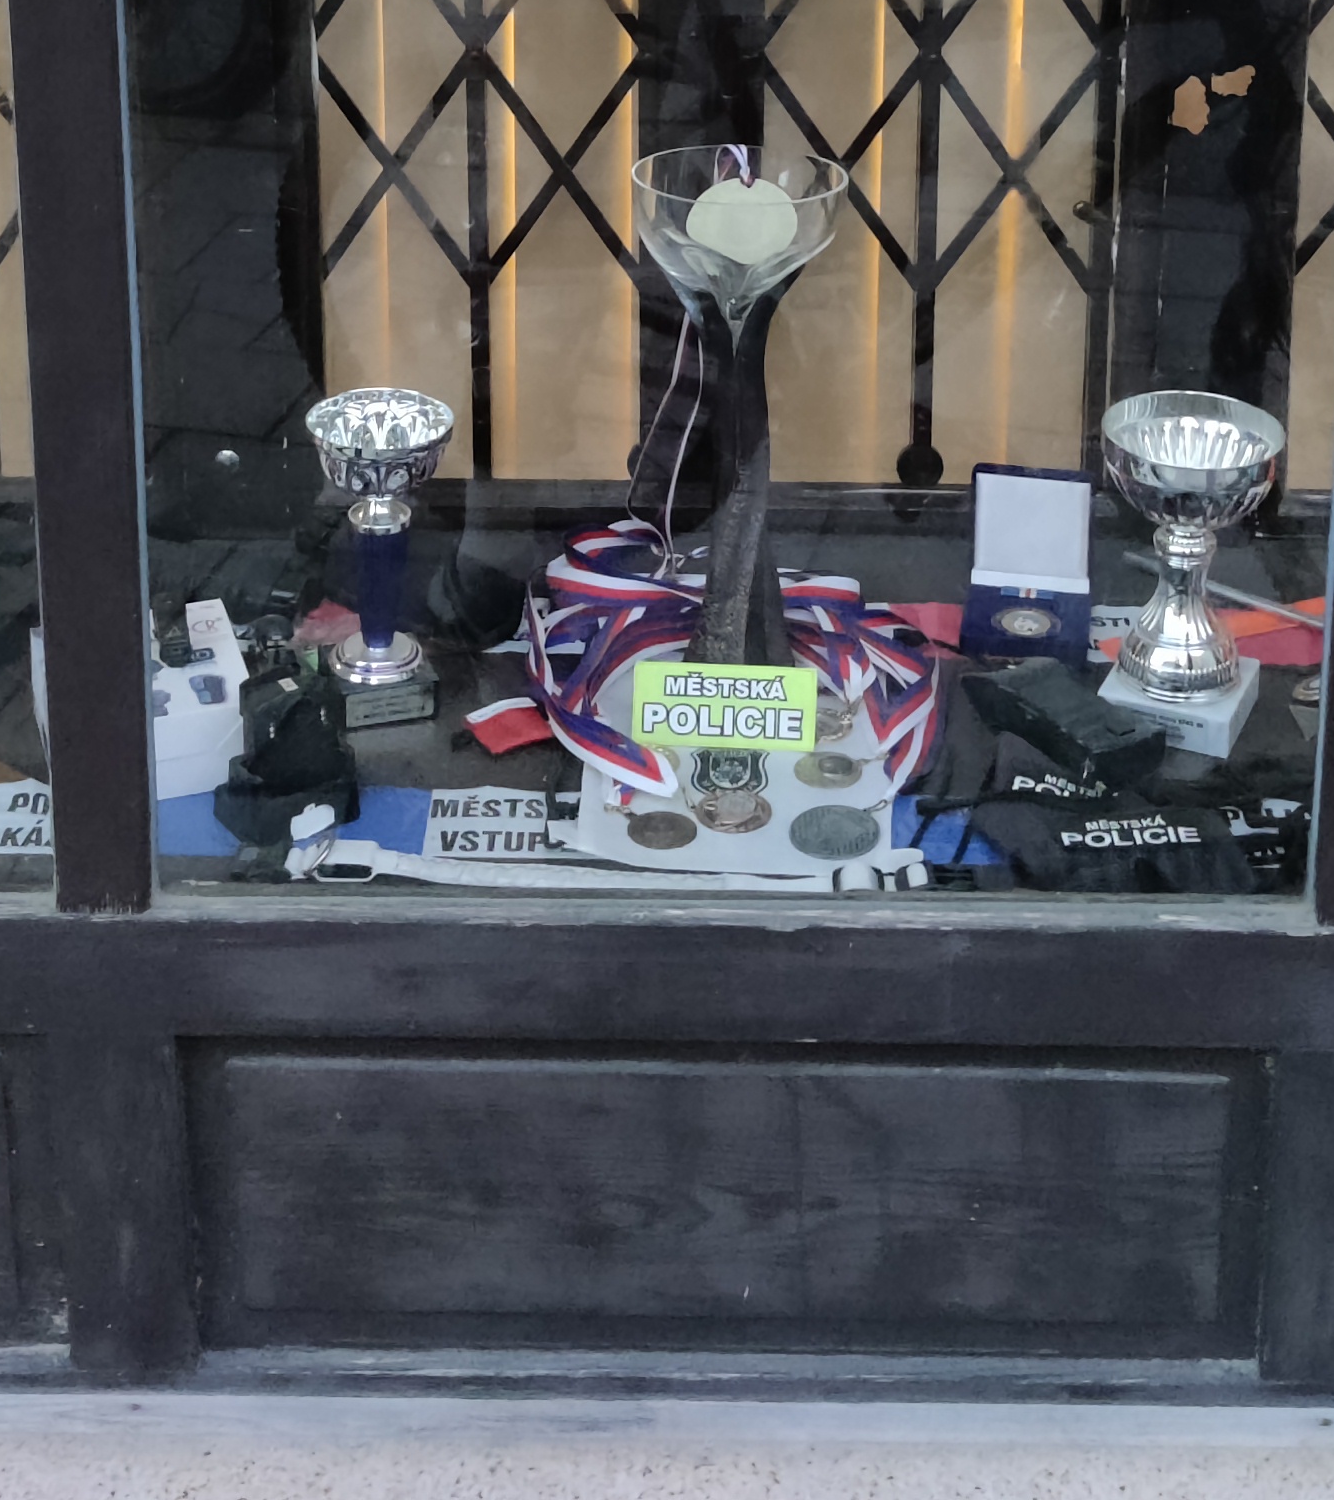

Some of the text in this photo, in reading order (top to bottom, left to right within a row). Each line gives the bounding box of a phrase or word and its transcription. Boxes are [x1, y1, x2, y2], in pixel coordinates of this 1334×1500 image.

[664, 671, 787, 701] MĚSTSKÁ
[642, 702, 804, 741] POLICIE
[440, 830, 547, 852] VSTUP
[1060, 825, 1202, 848] POLICIE
